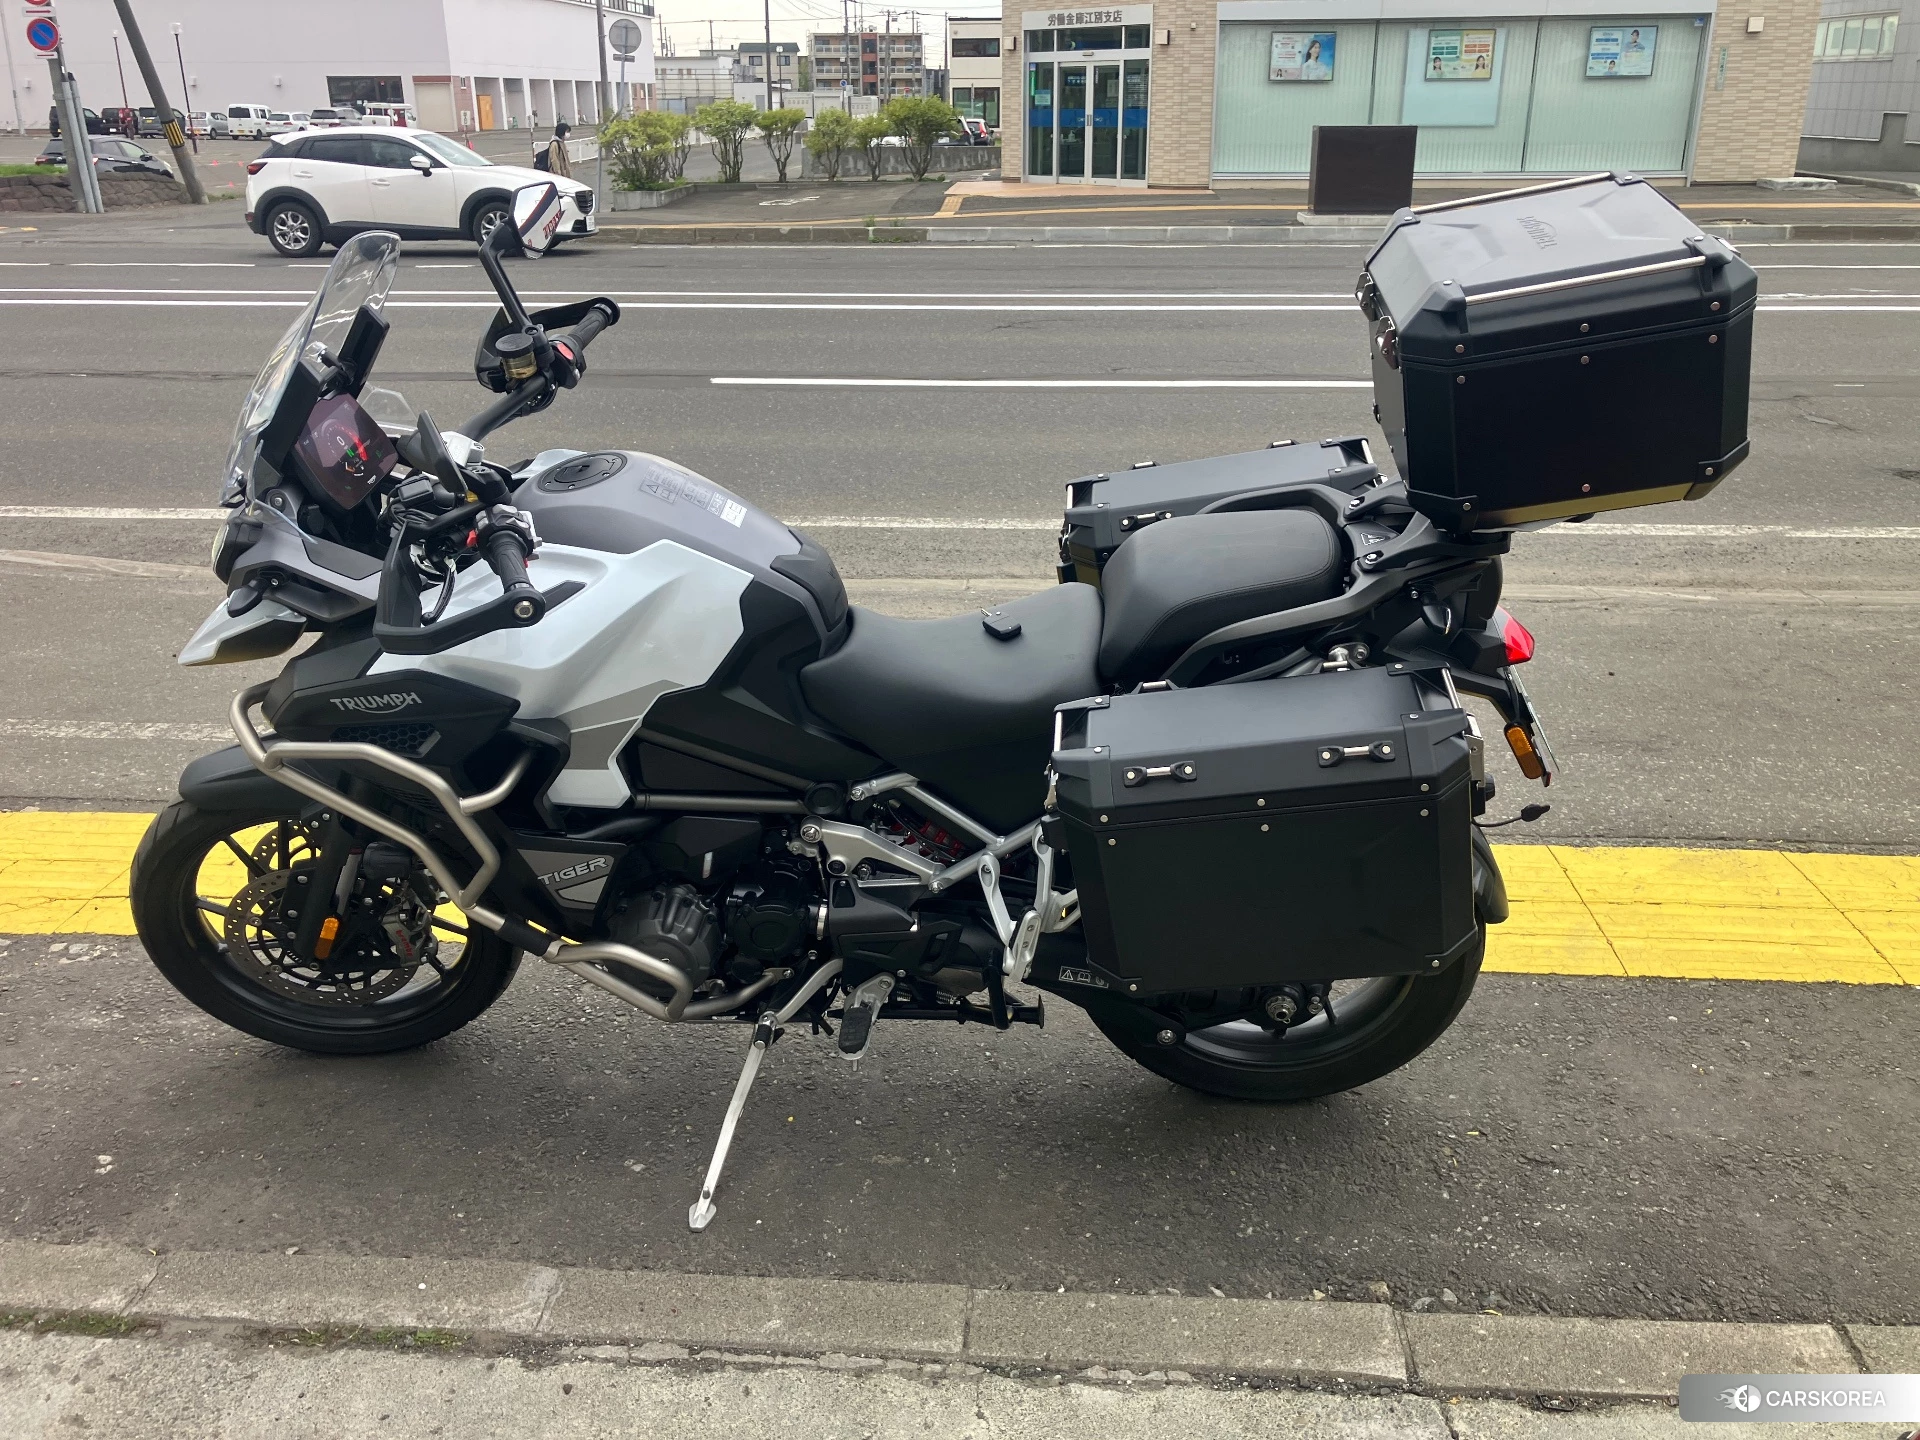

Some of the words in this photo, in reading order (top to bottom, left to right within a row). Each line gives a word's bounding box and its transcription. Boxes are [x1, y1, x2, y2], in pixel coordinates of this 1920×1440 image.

[1047, 10, 1123, 27] 労働金庫江別支店
[330, 692, 422, 714] TRIUMPH
[537, 857, 608, 885] TIGER
